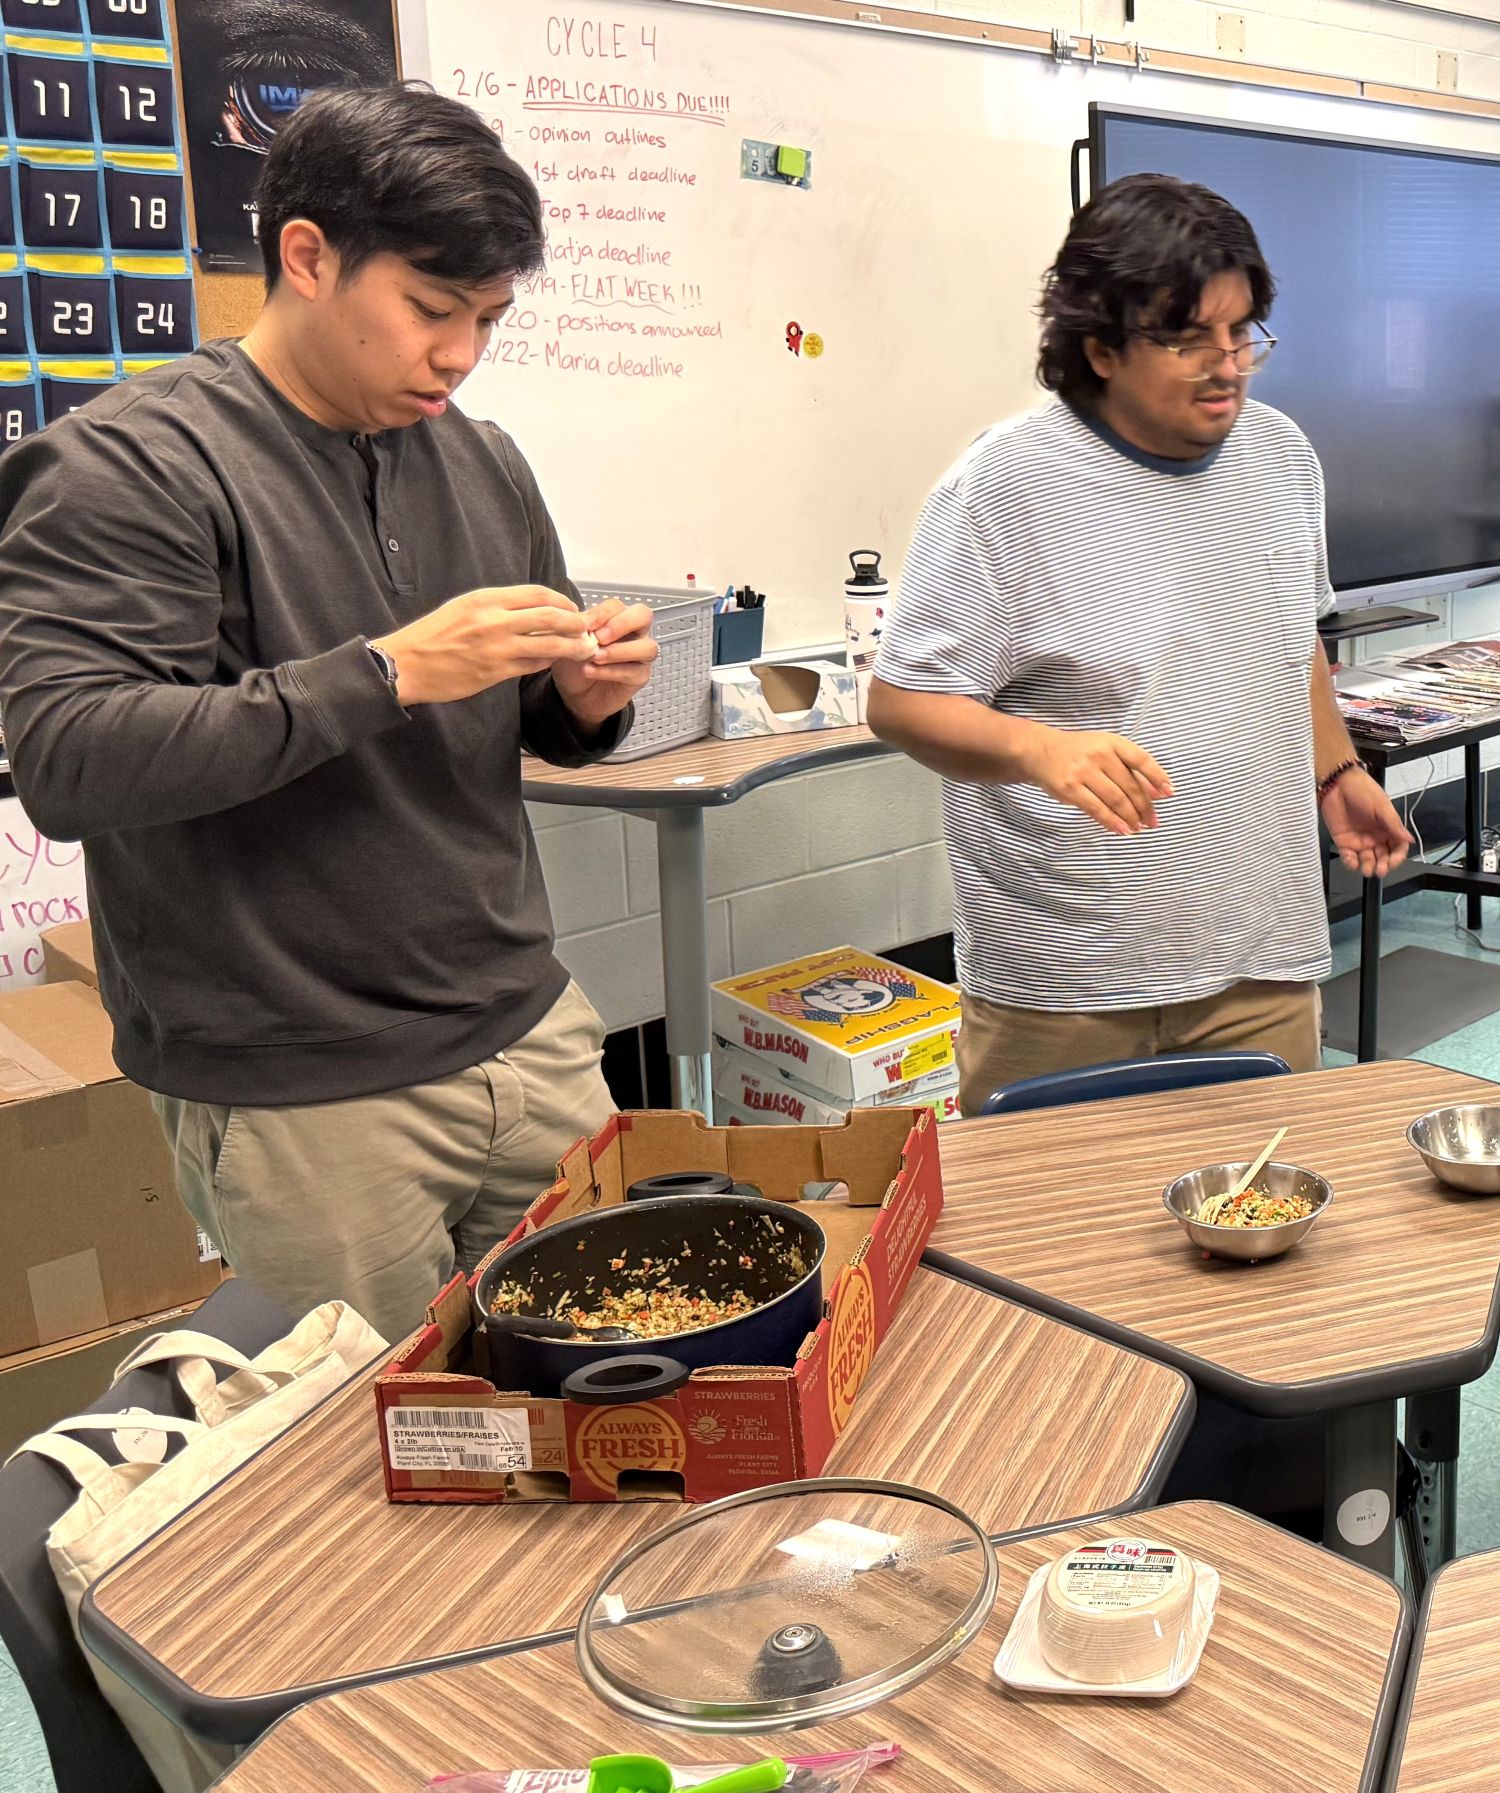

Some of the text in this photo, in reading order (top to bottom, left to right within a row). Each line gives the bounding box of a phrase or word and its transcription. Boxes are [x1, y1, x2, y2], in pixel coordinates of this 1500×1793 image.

[547, 16, 657, 61] CYCLE 4
[33, 80, 70, 118] 11
[119, 85, 157, 122] 12
[452, 68, 500, 98] 2/6
[525, 75, 668, 110] APPLICATIONS
[528, 125, 591, 144] opinion
[604, 127, 667, 149] outlines
[533, 160, 697, 186] 1st draft deadline
[751, 160, 759, 172] 5
[44, 193, 81, 228] 17
[130, 196, 167, 230] 18
[576, 203, 590, 221] 7
[596, 205, 667, 223] deadline
[598, 240, 672, 267] deadline
[571, 273, 618, 301] FLAT
[624, 276, 675, 304] WEEK
[53, 301, 94, 335] 23
[137, 302, 175, 335] 24
[557, 313, 637, 335] positions
[642, 321, 723, 338] announced
[545, 341, 600, 371] Maria
[607, 352, 684, 378] deadline
[743, 1026, 809, 1064] W.B.MASON
[873, 1048, 905, 1068] WHO BU
[743, 1086, 806, 1122] W.B.MASON
[836, 1286, 865, 1355] ALWAYS
[831, 1303, 873, 1410] FRESH
[694, 1391, 776, 1400] STRAWBERRIES
[393, 1430, 500, 1440] STRAWBERRIES/FRAISES
[596, 1422, 663, 1435] ALWAYS
[581, 1438, 681, 1459] FRESH
